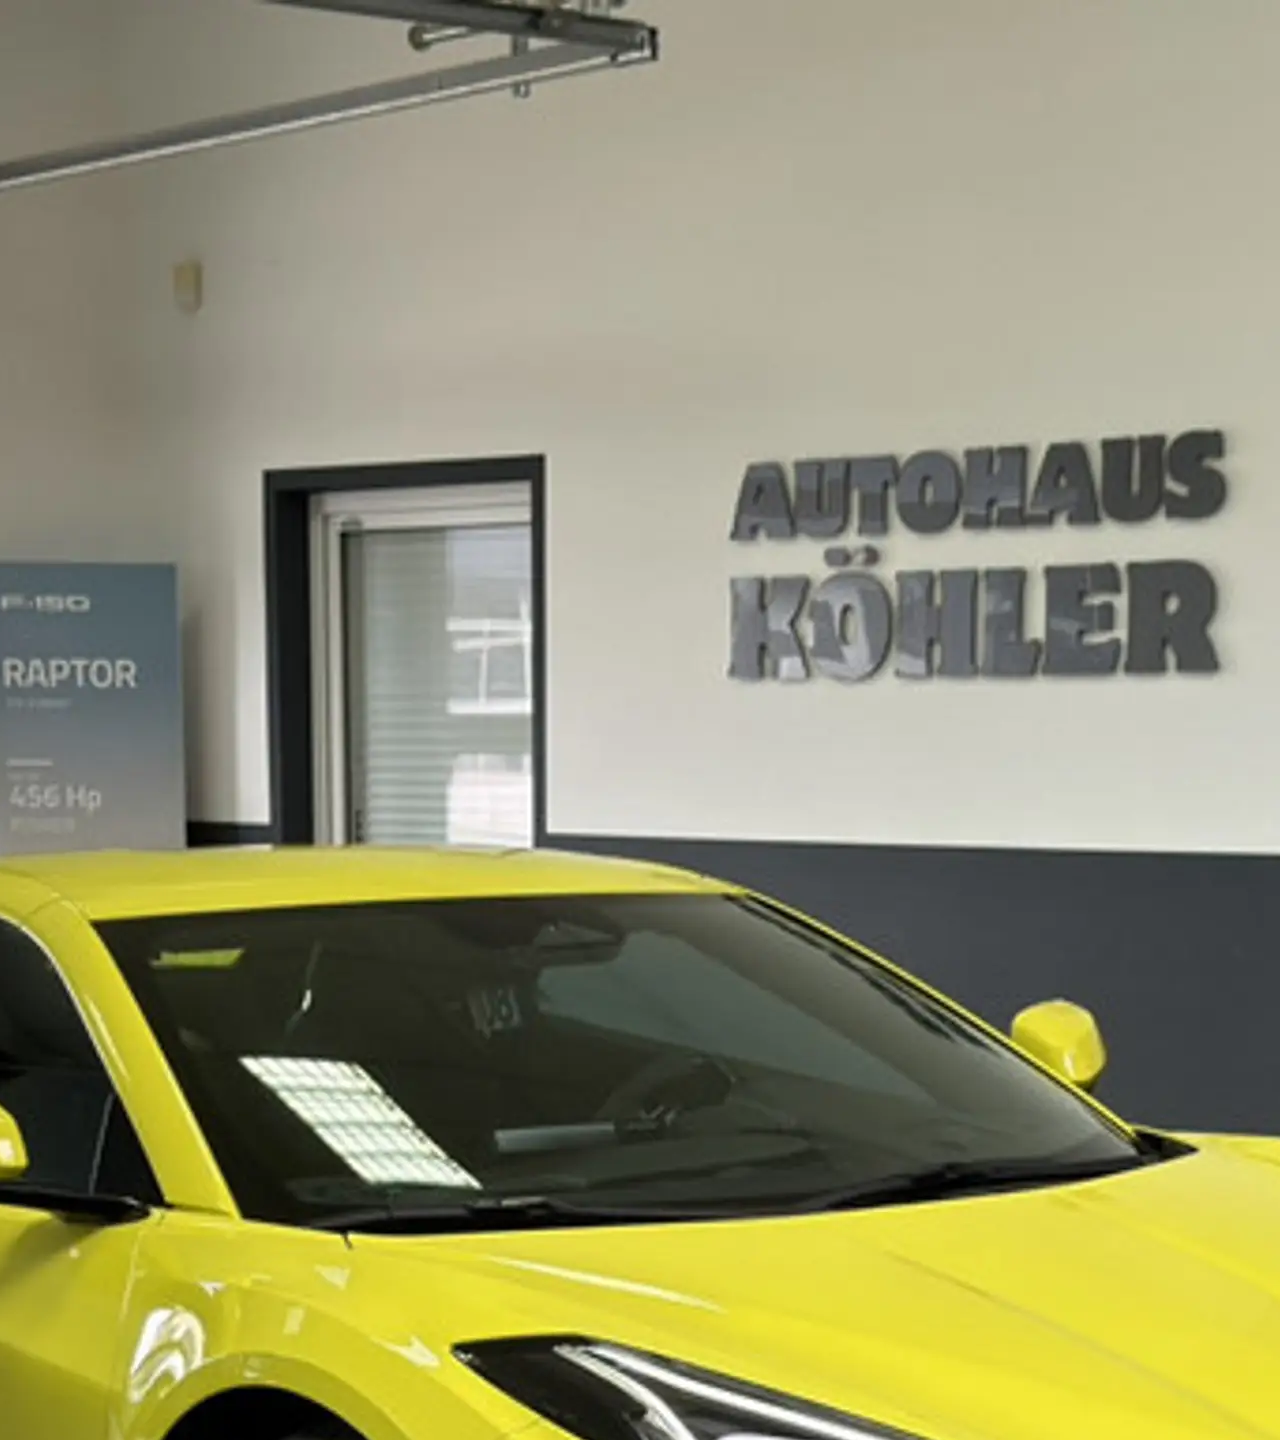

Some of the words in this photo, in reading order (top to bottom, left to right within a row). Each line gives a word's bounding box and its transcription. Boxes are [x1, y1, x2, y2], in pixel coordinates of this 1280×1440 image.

[729, 429, 1229, 541] AUTOHAUS
[726, 545, 1220, 683] KÖHLER
[1, 656, 138, 689] RAPTOR
[9, 783, 61, 809] 456
[65, 783, 102, 817] Hp
